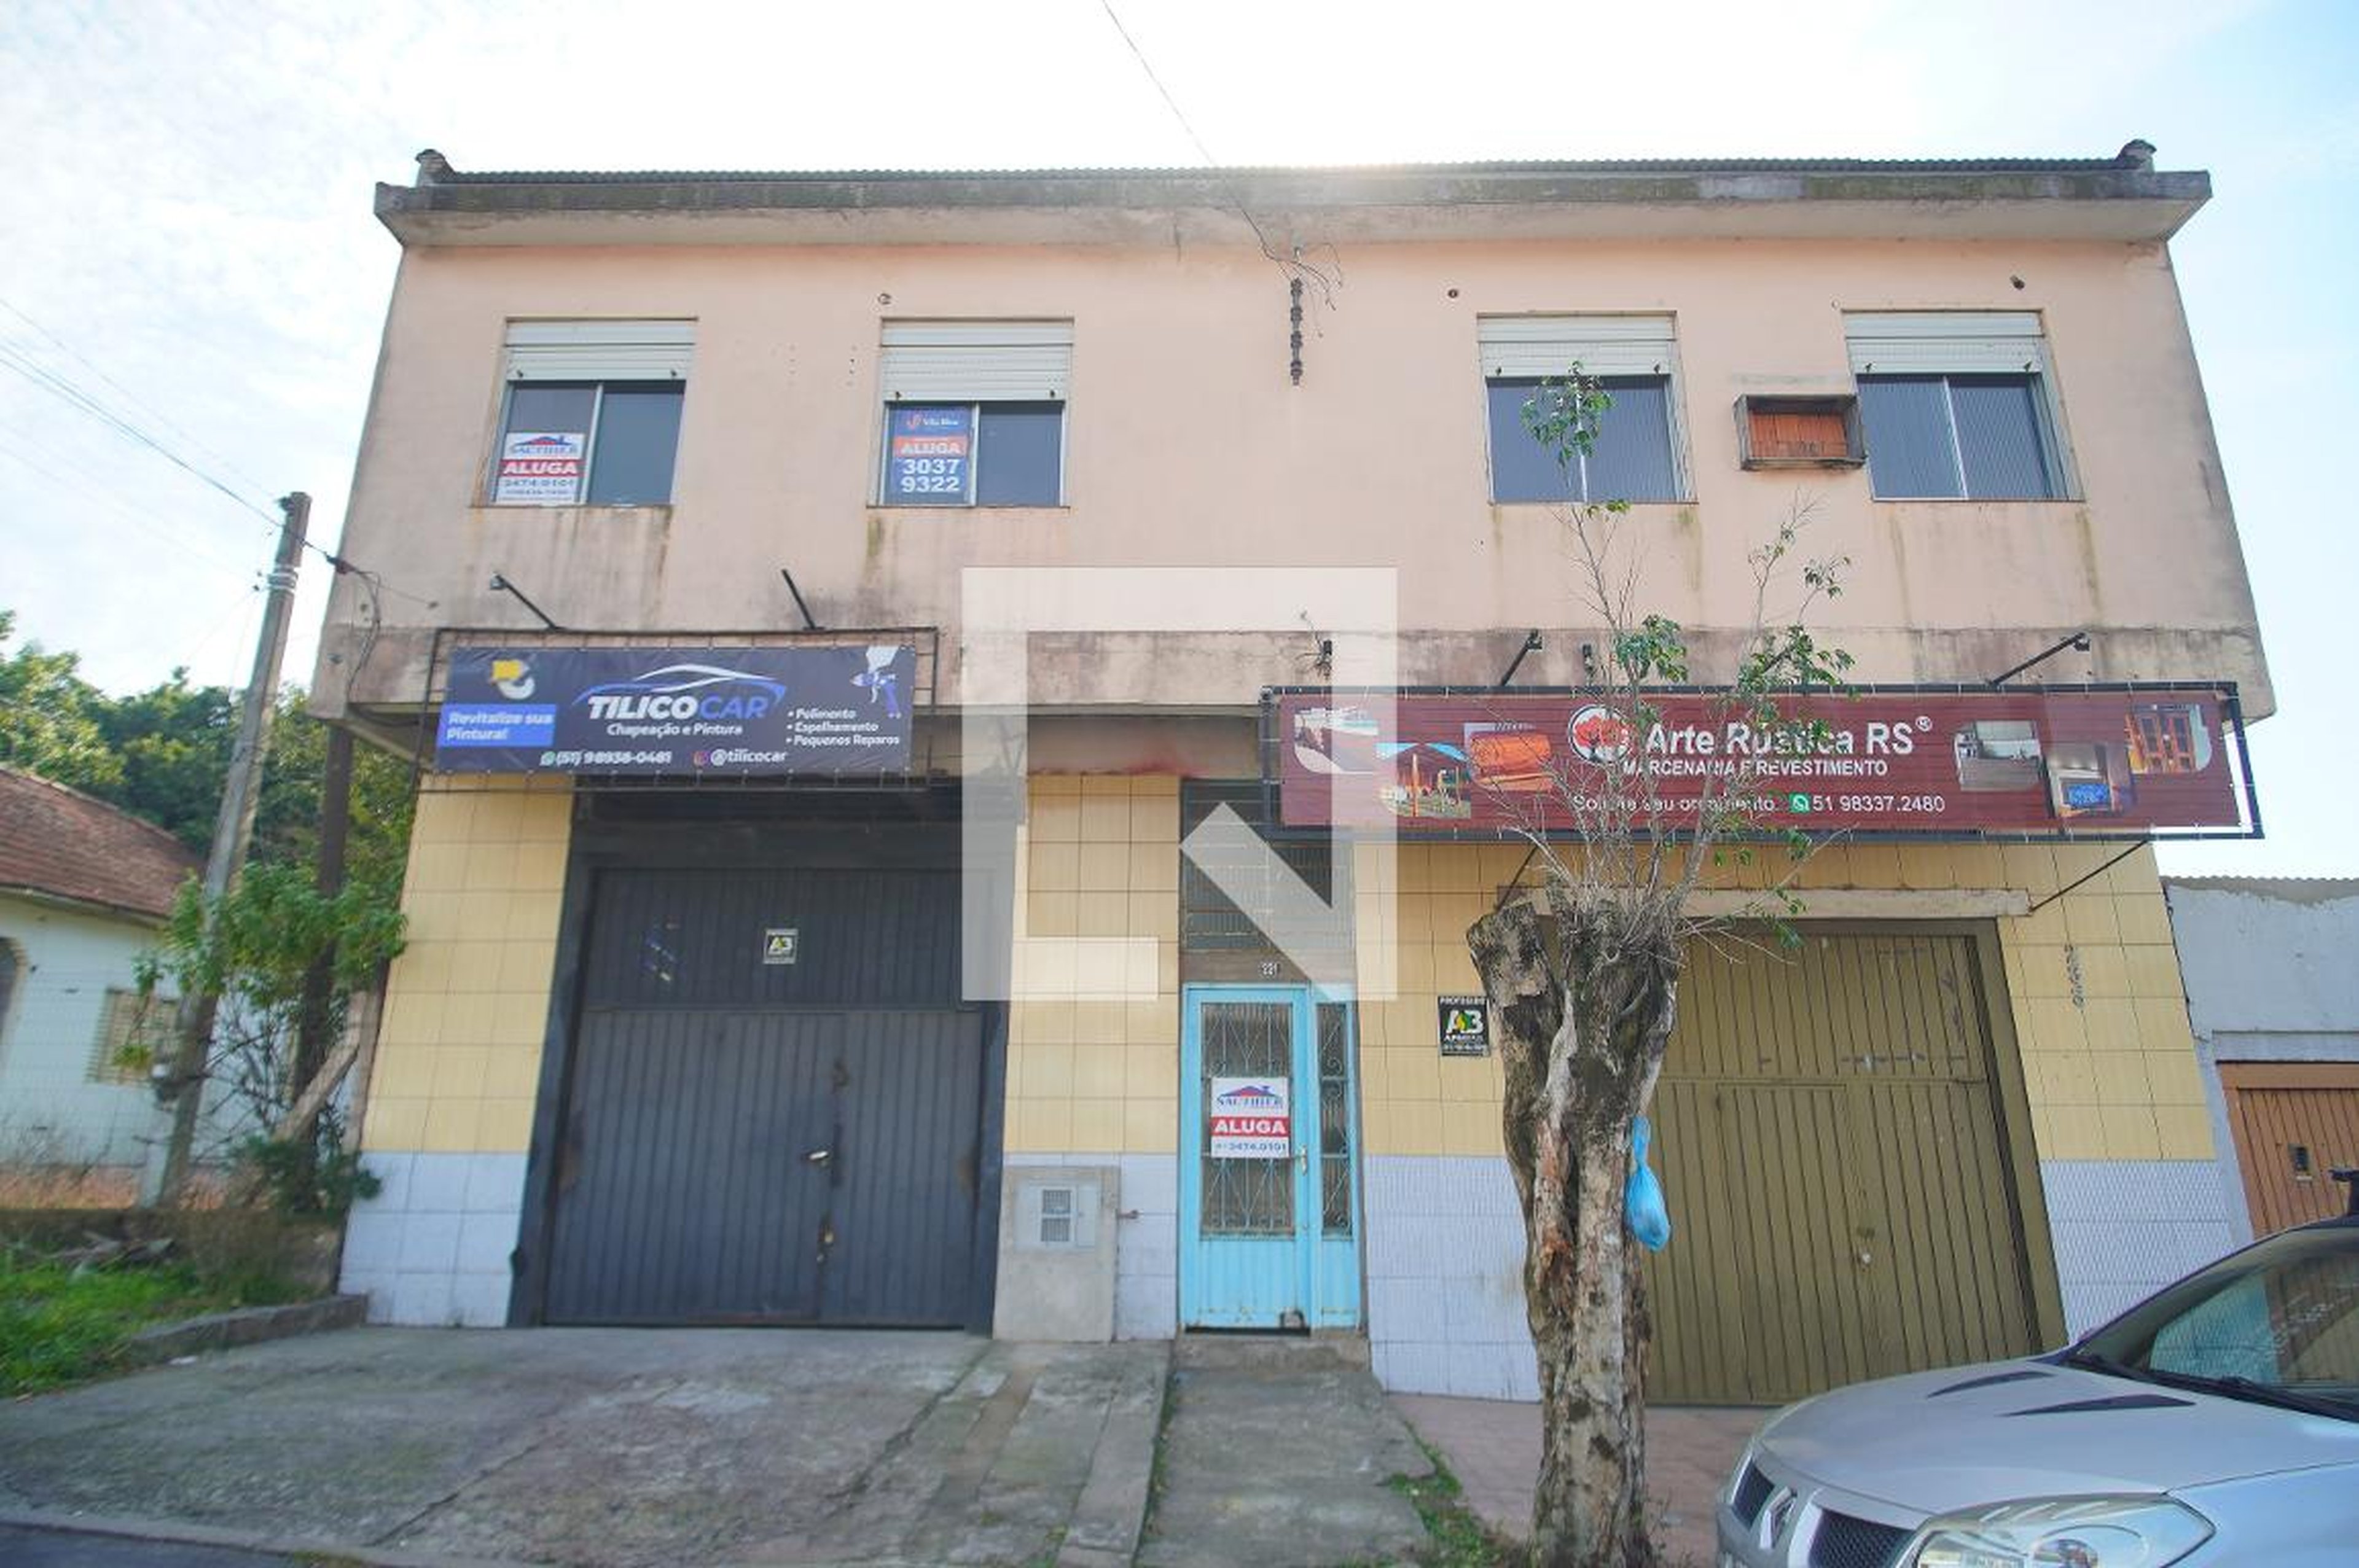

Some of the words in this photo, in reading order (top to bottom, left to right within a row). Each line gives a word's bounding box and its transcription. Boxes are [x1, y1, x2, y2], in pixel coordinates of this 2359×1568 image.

[901, 443, 962, 454] ALUGA
[503, 461, 578, 474] ALUGA
[902, 459, 961, 474] 3037
[901, 476, 960, 492] 9322
[525, 713, 554, 725] sua
[796, 708, 856, 720] Polimento
[606, 723, 680, 738] Chapeação
[682, 726, 691, 735] e
[693, 722, 743, 735] Pintura
[794, 720, 879, 734] Espelhamento
[793, 735, 851, 748] Pequenos
[853, 734, 901, 747] Reparos
[1646, 722, 1715, 754] Arte
[710, 748, 788, 766] @tilicocar
[1623, 759, 1735, 775] MRCENARIA
[1756, 759, 1888, 776] REVESTIMENTO
[1813, 795, 1833, 811] 51
[1840, 795, 1946, 812] 98337.2480
[1214, 1119, 1286, 1134] ALUGA
